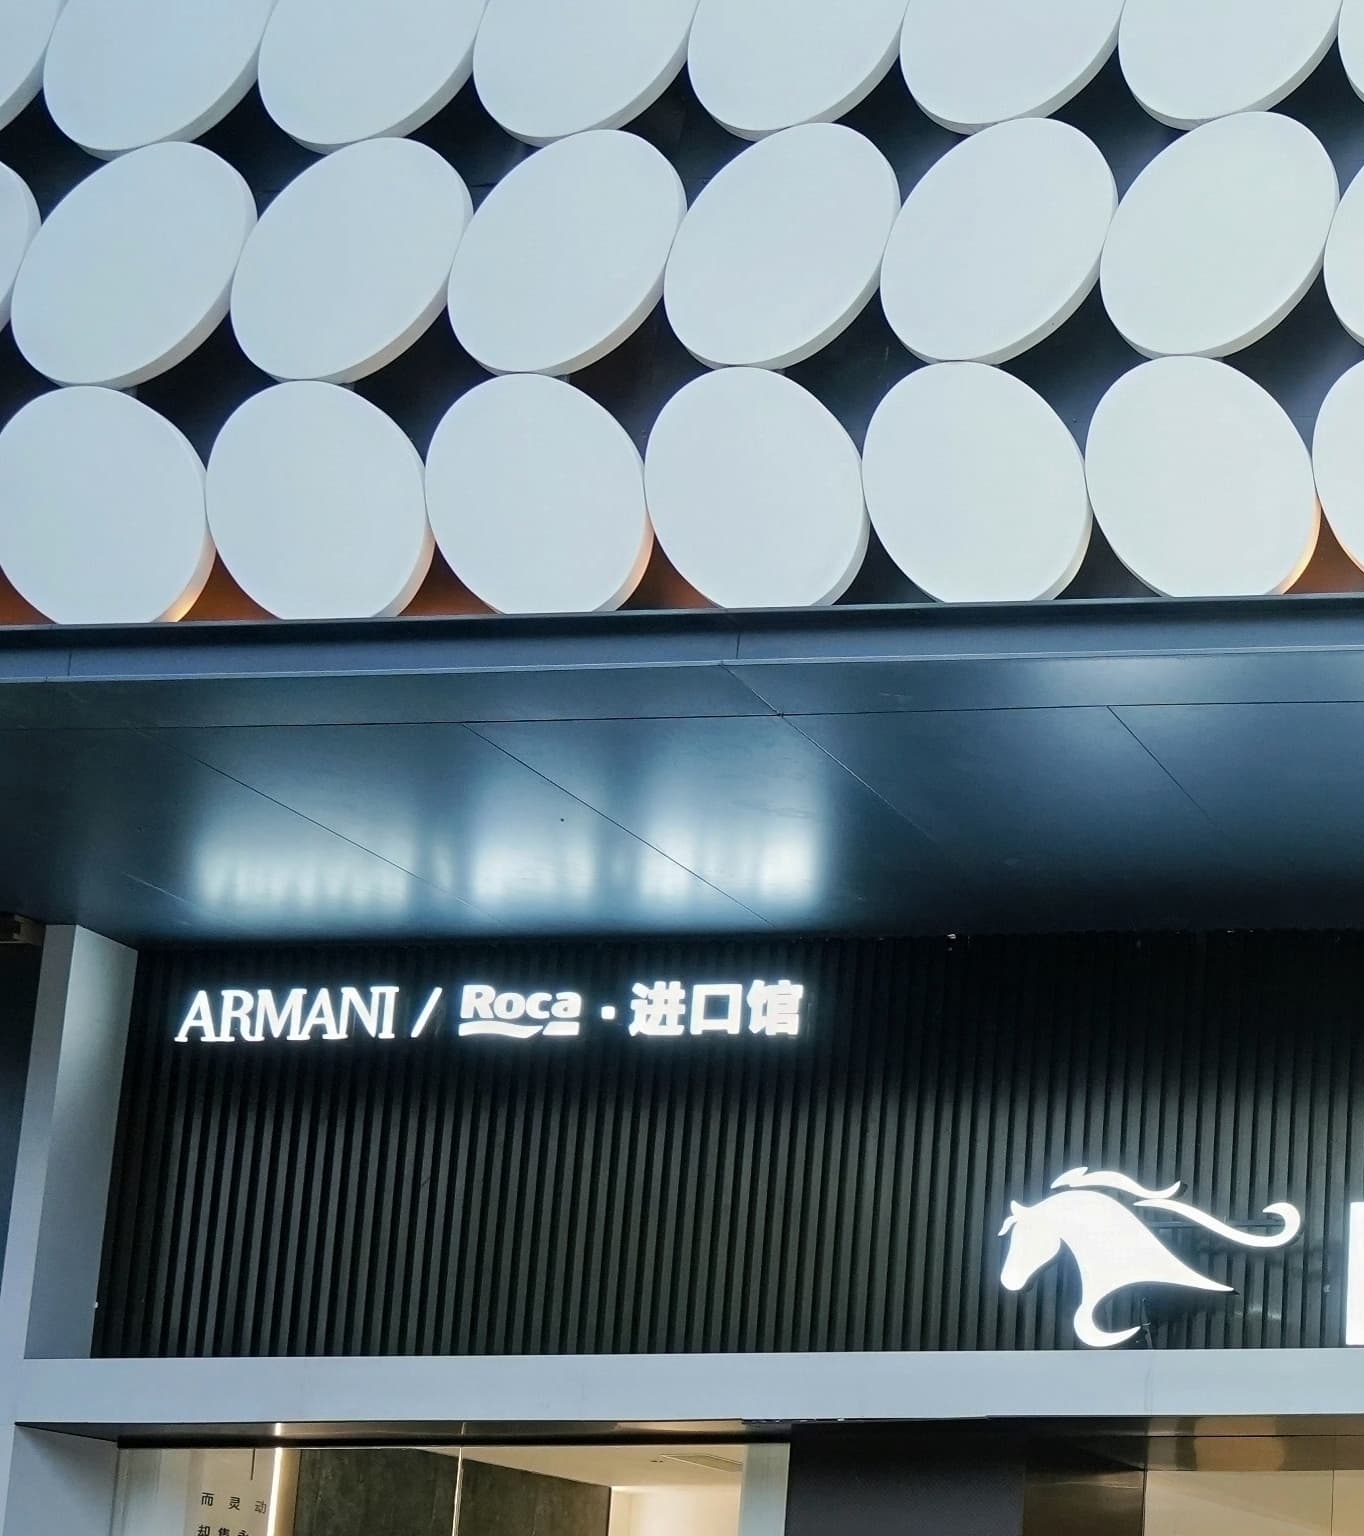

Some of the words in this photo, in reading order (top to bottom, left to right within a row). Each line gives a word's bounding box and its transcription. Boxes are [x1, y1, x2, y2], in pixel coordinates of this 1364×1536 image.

[174, 986, 399, 1042] ARMANI
[460, 985, 581, 1021] Roca
[629, 979, 804, 1037] 进口馆
